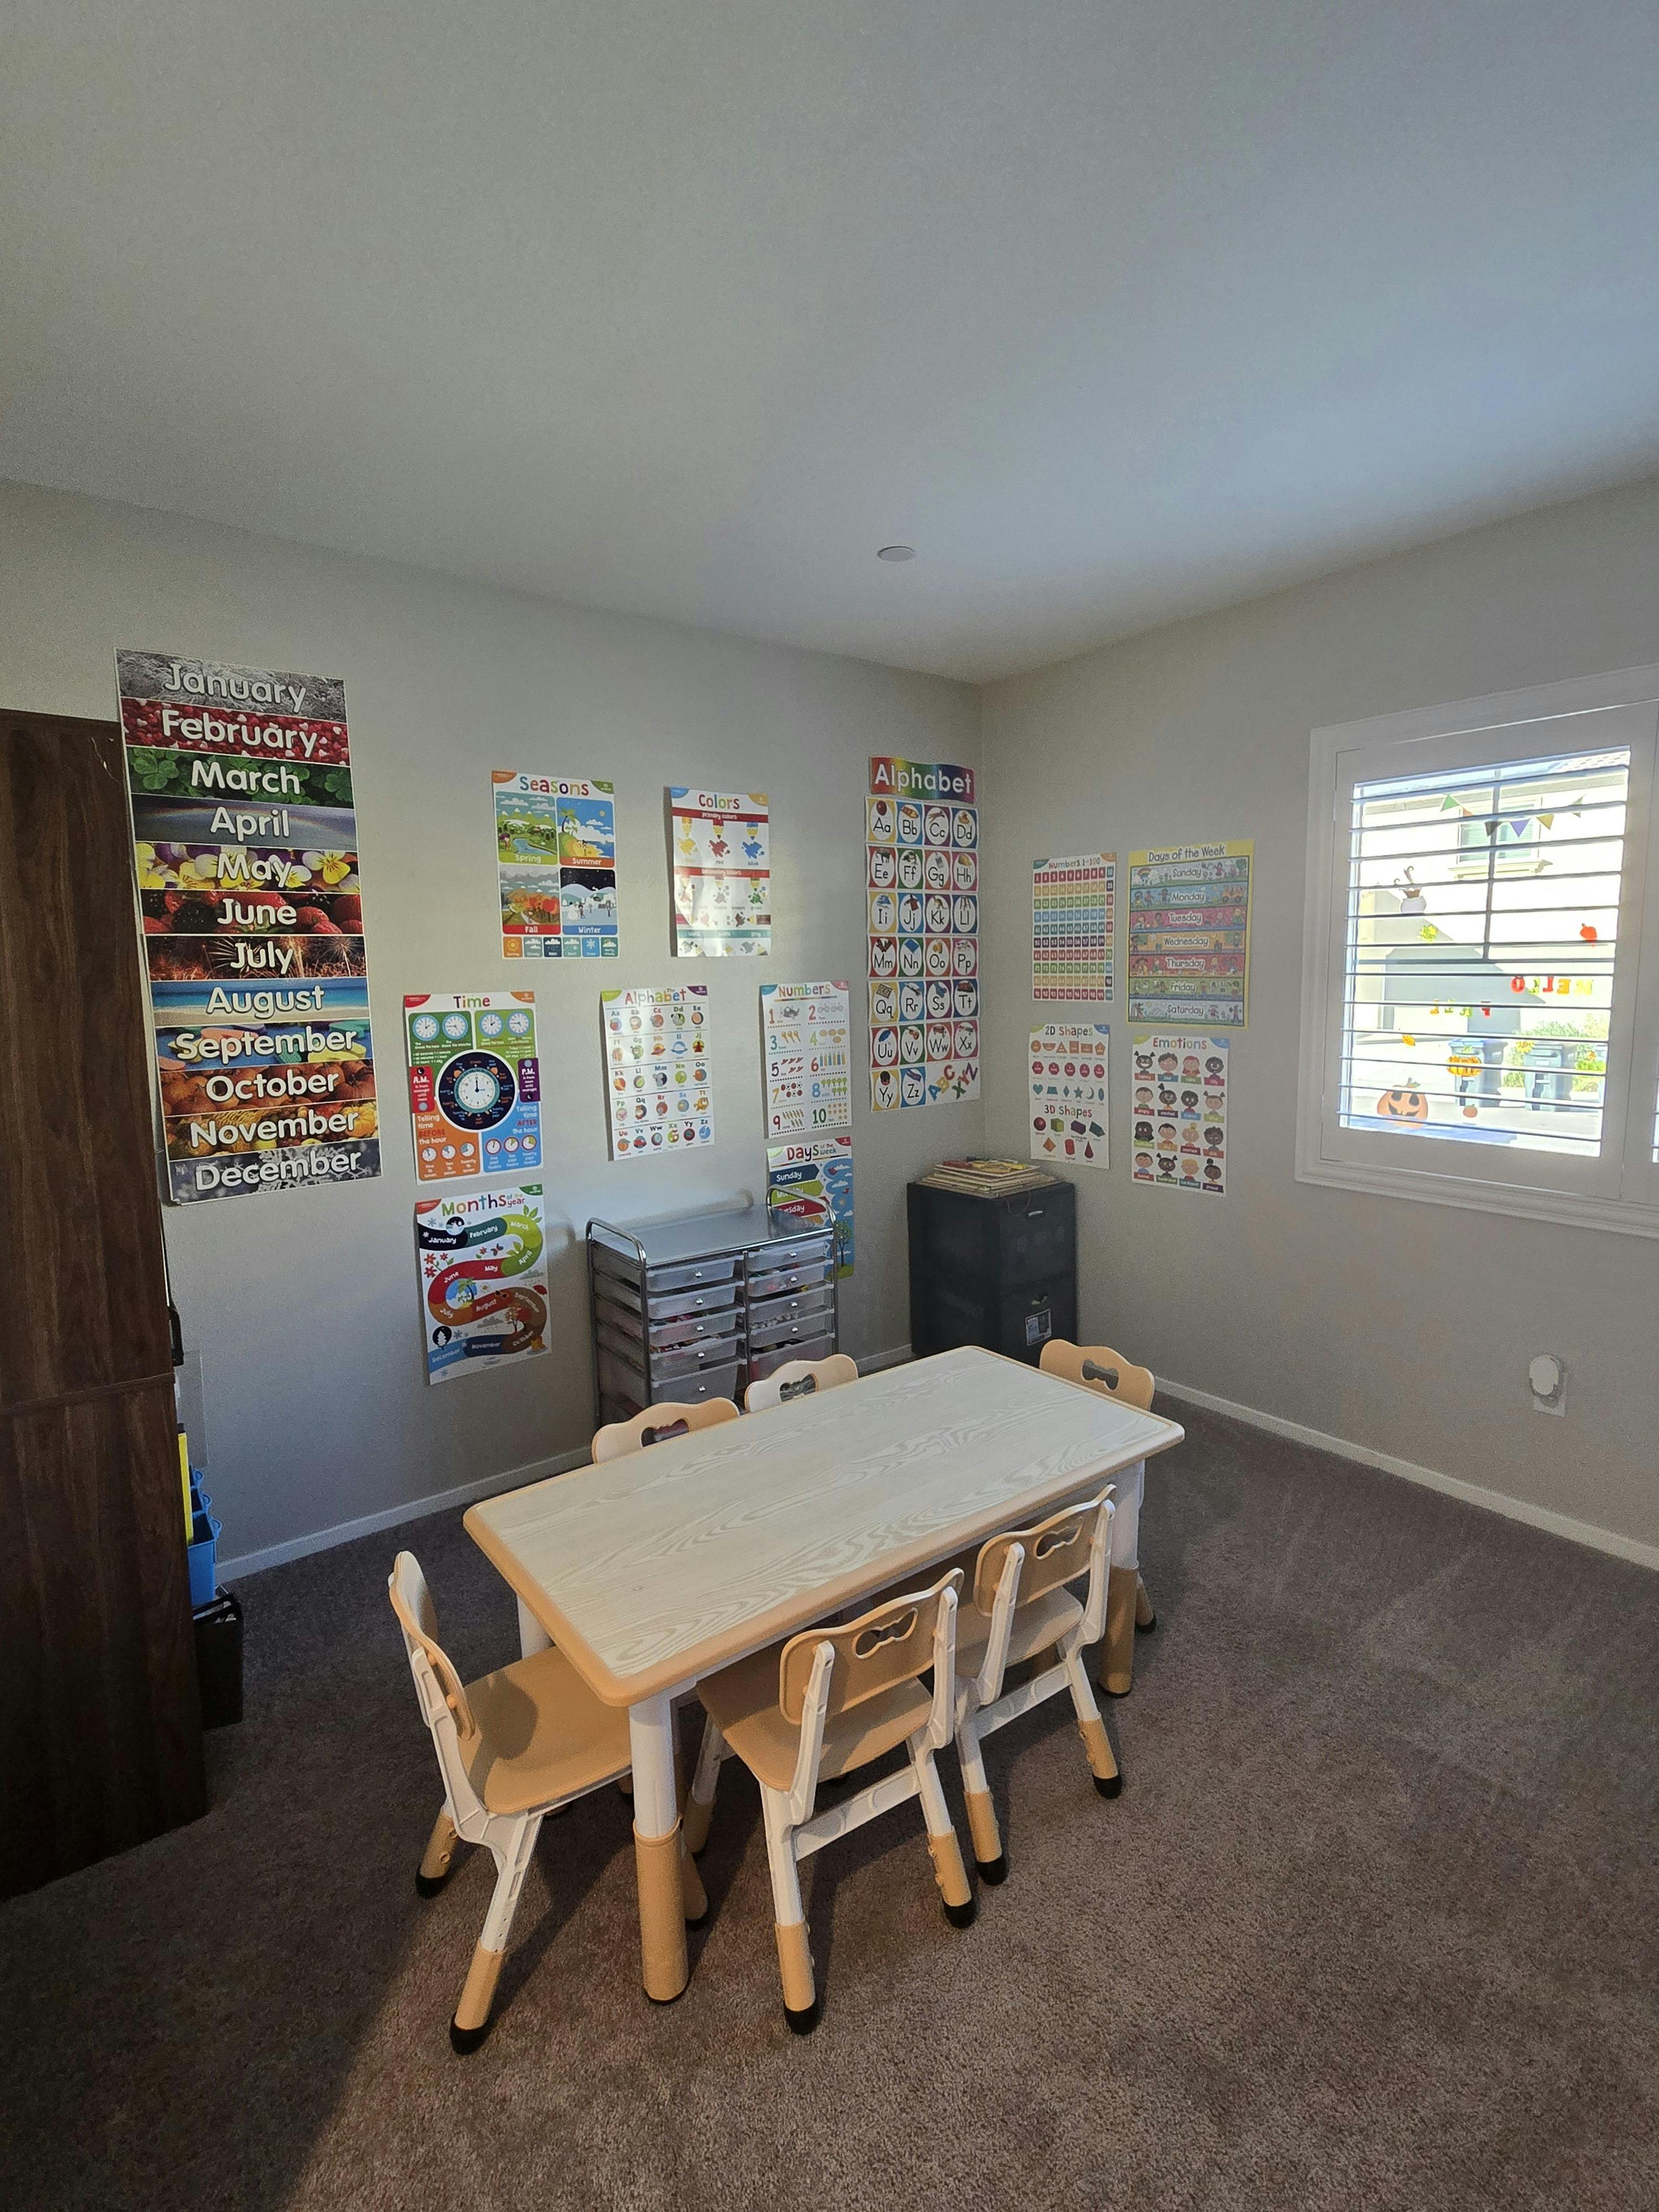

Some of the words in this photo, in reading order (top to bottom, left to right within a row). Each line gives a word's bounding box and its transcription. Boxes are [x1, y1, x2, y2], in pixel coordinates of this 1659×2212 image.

[165, 664, 306, 713] January
[162, 709, 318, 758] February
[191, 760, 300, 794] March
[875, 764, 972, 794] Alphabet
[519, 776, 589, 796] Seasons
[698, 794, 740, 810] Colors
[210, 807, 289, 841] April
[873, 817, 891, 833] Aa
[902, 820, 917, 836] Bb
[930, 822, 946, 837] Cc
[957, 825, 972, 840] Dd
[515, 854, 541, 863] Spring
[1149, 852, 1170, 862] Days
[1172, 848, 1182, 859] of
[1185, 848, 1199, 858] the
[1202, 845, 1224, 857] Week
[217, 853, 292, 888] May
[874, 863, 889, 879] Ee
[1049, 860, 1080, 869] Numbers
[904, 865, 916, 881] Ff
[928, 867, 945, 887] Gg
[957, 868, 972, 883] Hh
[1172, 868, 1201, 878] Sunday
[1172, 892, 1204, 902] Monday
[217, 899, 297, 925] June
[931, 910, 945, 925] Kk
[960, 910, 969, 925] Ll
[1170, 913, 1202, 923] Tuesday
[904, 910, 915, 931] Jj
[1164, 936, 1208, 947] Wednesday
[230, 942, 293, 974] July
[874, 954, 893, 968] Mm
[904, 954, 919, 969] Nn
[930, 954, 945, 968] Oo
[958, 954, 972, 973] Pp
[1167, 958, 1205, 968] Thursday
[779, 984, 831, 997] Numbers
[1170, 982, 1196, 992] Friday
[206, 985, 325, 1018] August
[453, 996, 490, 1008] Time
[625, 989, 686, 1006] Alphabet
[932, 997, 945, 1010] Ss
[958, 995, 972, 1009] Tt
[808, 1005, 816, 1020] 2
[875, 999, 894, 1019] Qq
[905, 998, 918, 1013] Rr
[1167, 1004, 1204, 1015] Saturday
[769, 1008, 775, 1024] 1
[810, 1031, 818, 1046] 4
[1045, 1026, 1055, 1035] 2D
[1059, 1026, 1093, 1038] Shapes
[176, 1026, 357, 1064] September
[770, 1035, 778, 1050] 3
[906, 1042, 918, 1056] Vv
[930, 1039, 948, 1052] Ww
[959, 1036, 972, 1051] Xx
[1153, 1037, 1207, 1049] Emotions
[878, 1044, 893, 1058] Uu
[771, 1062, 779, 1077] 5
[811, 1057, 819, 1072] 6
[206, 1070, 338, 1101] October
[812, 1083, 821, 1098] 8
[907, 1084, 919, 1098] Zz
[773, 1088, 779, 1104] 7
[879, 1087, 893, 1107] Yy
[813, 1108, 826, 1124] 10
[1044, 1104, 1055, 1114] 3D
[1059, 1105, 1092, 1119] Shapes
[190, 1110, 358, 1147] November
[773, 1115, 780, 1130] 9
[786, 1145, 819, 1161] Days
[196, 1151, 362, 1191] December
[776, 1171, 802, 1182] Sunday
[442, 1194, 507, 1216] Months
[507, 1198, 525, 1208] year
[469, 1225, 498, 1238] February
[510, 1221, 529, 1230] March
[518, 1250, 533, 1265] April
[444, 1272, 459, 1283] June
[440, 1308, 453, 1318] July
[476, 1299, 497, 1312] August
[432, 1348, 460, 1363] December
